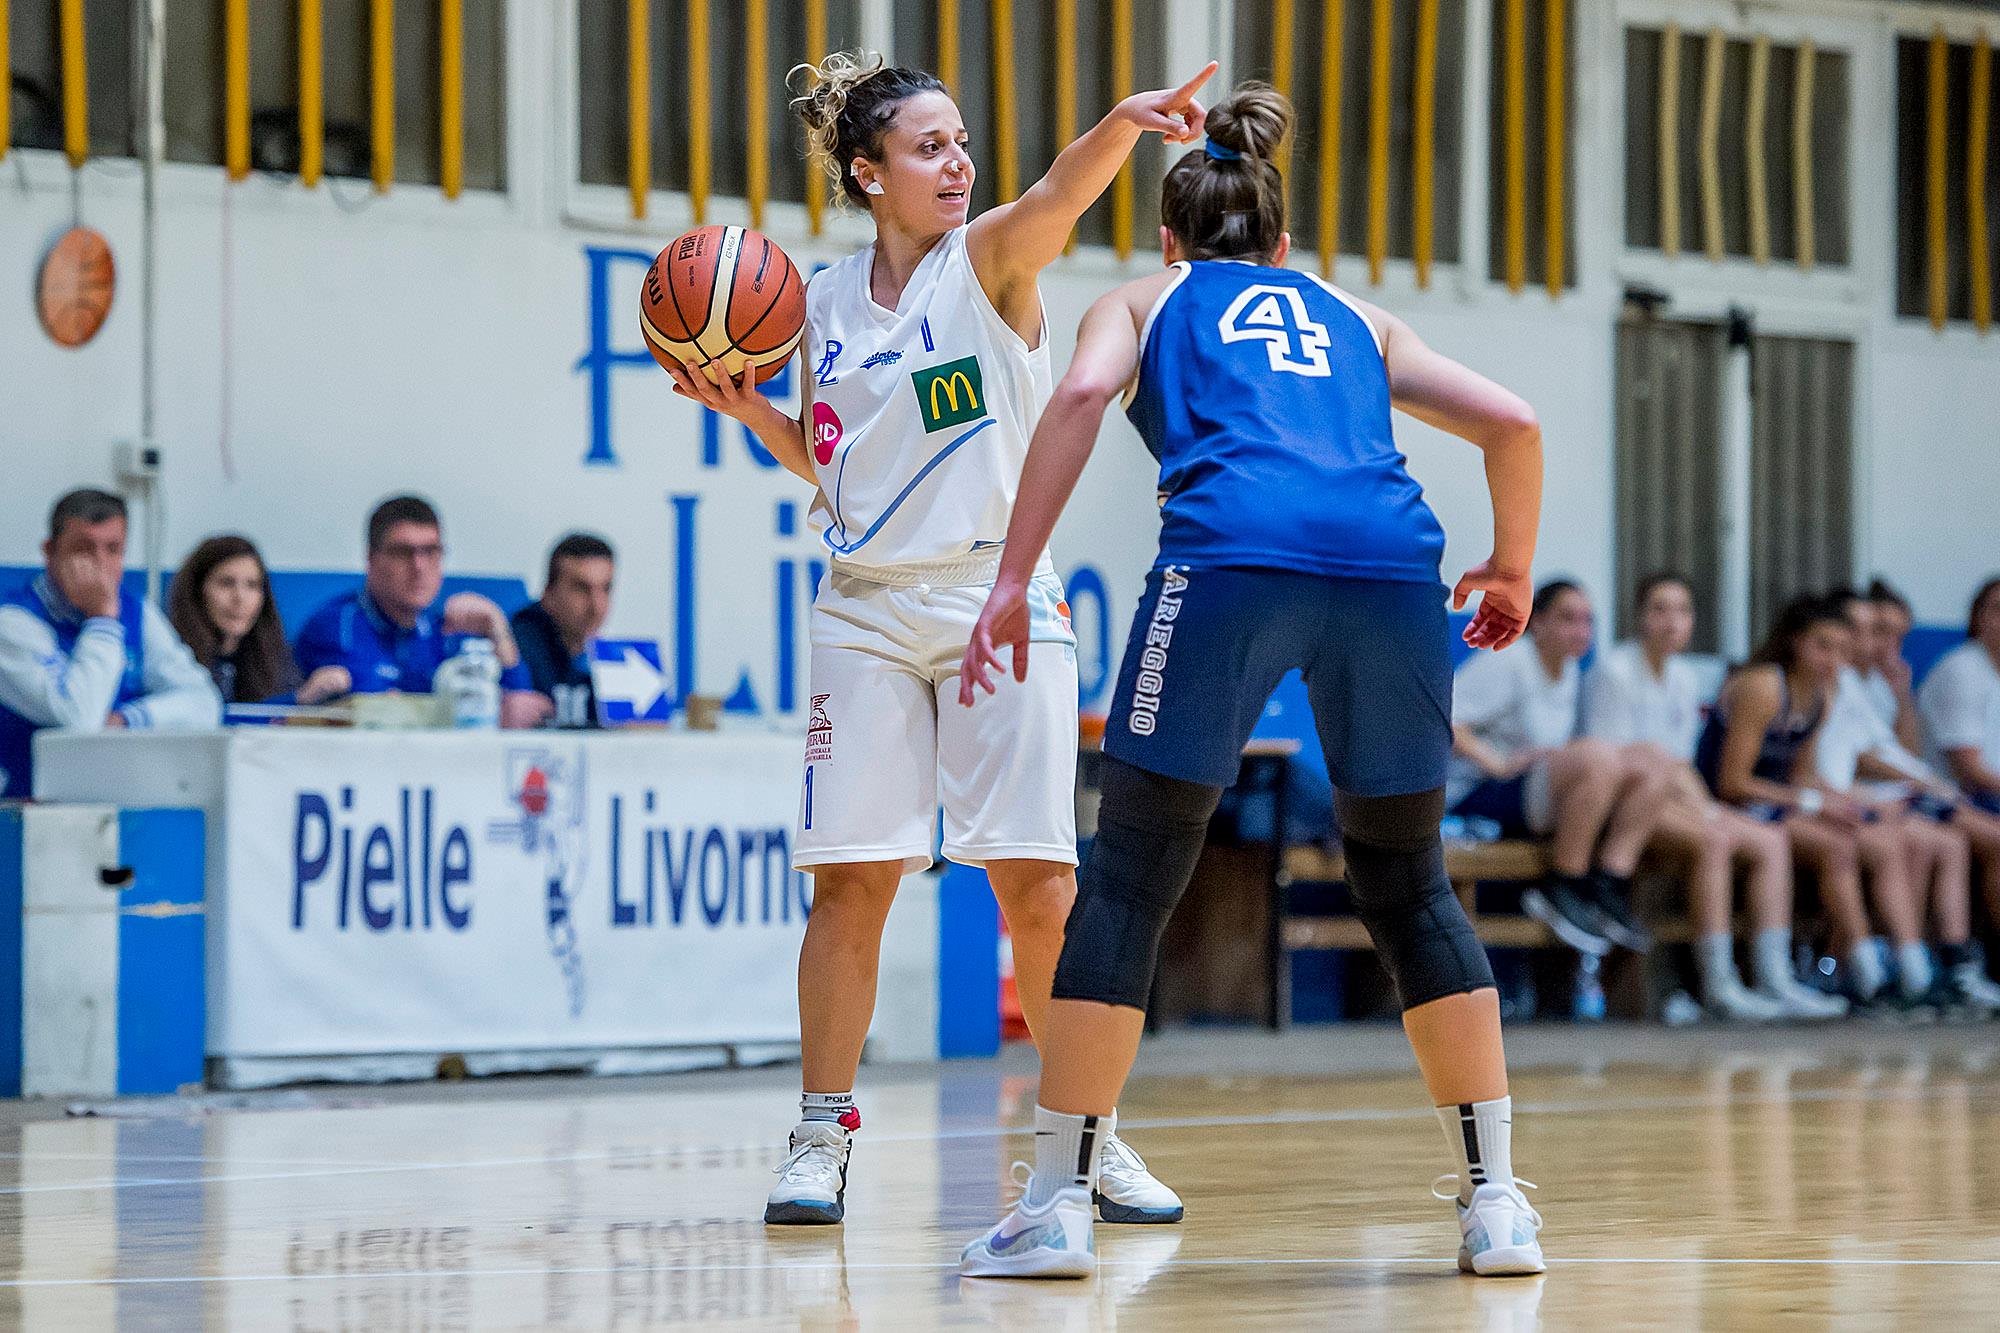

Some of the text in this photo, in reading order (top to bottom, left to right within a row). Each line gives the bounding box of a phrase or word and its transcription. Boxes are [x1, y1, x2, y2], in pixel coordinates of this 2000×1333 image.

[678, 234, 698, 261] FIBA
[725, 235, 736, 259] GM6X
[1217, 283, 1332, 377] 4
[1129, 565, 1190, 736] AREGGIO
[805, 765, 813, 829] 1
[290, 785, 472, 933] Pielle
